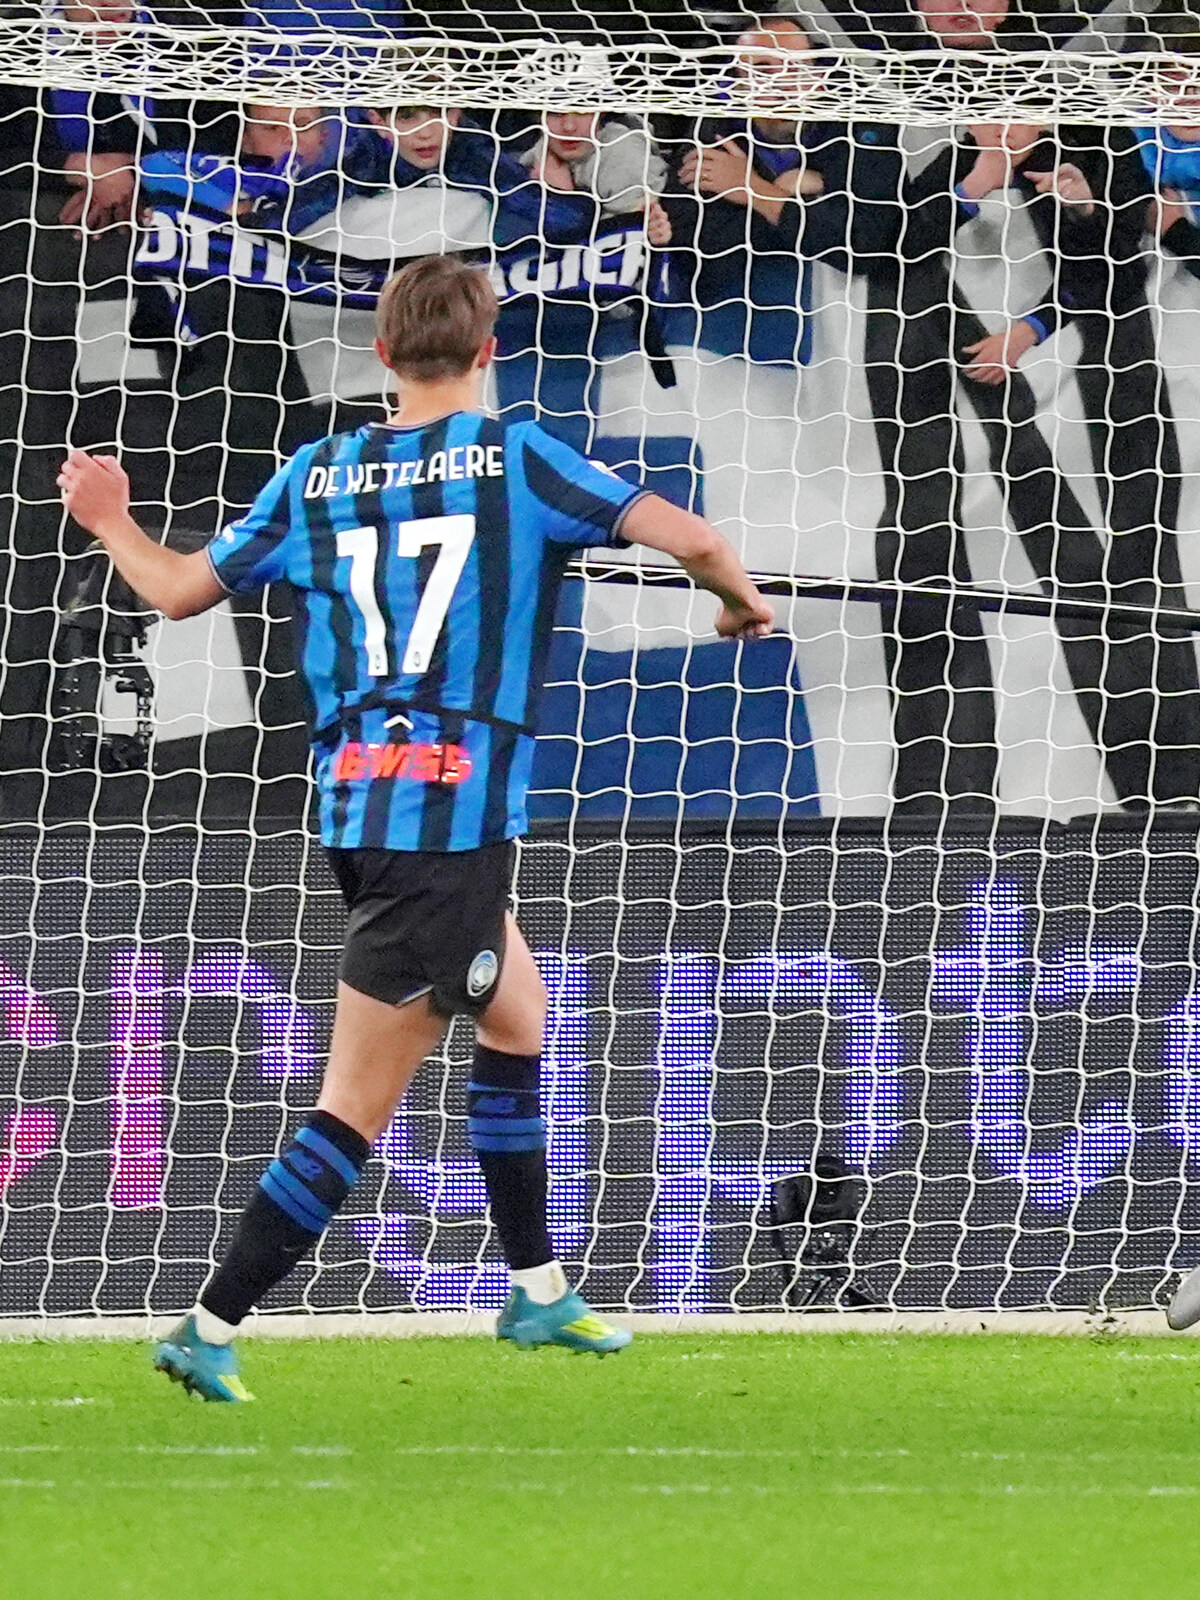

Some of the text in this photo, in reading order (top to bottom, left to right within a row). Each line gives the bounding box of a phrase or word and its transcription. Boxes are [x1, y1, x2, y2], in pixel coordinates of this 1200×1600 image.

[304, 444, 504, 499] DE KETELAERE
[336, 513, 476, 676] 17
